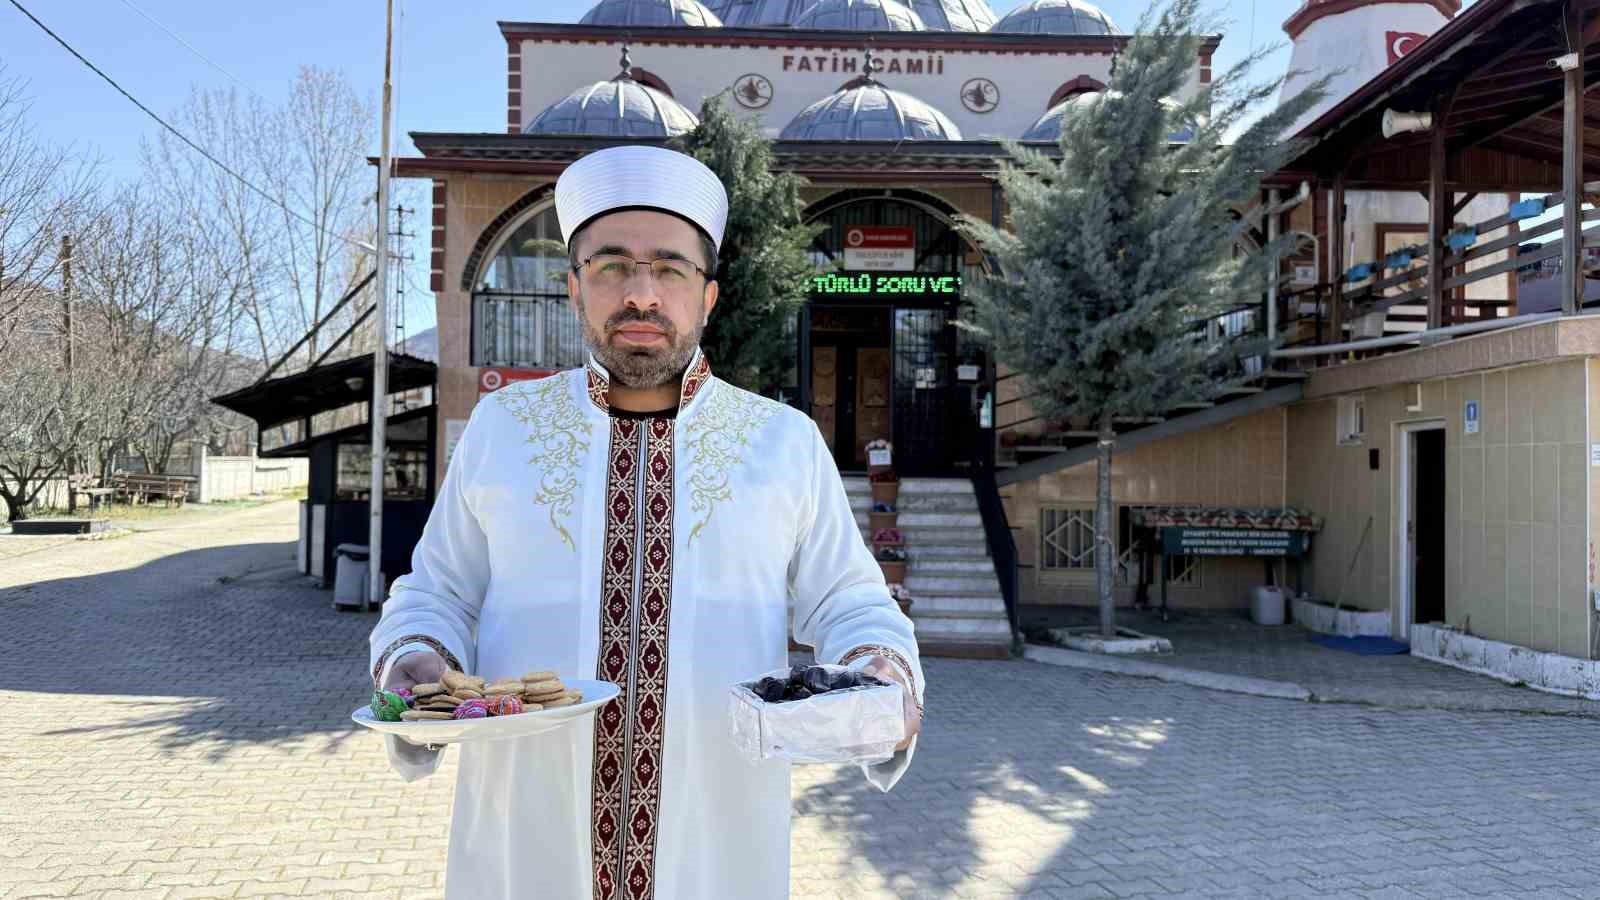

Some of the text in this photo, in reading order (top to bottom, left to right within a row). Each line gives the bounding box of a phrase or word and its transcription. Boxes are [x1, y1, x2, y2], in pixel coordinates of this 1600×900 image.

[783, 53, 944, 75] FATİH CAMİİ
[876, 276, 926, 293] SORU
